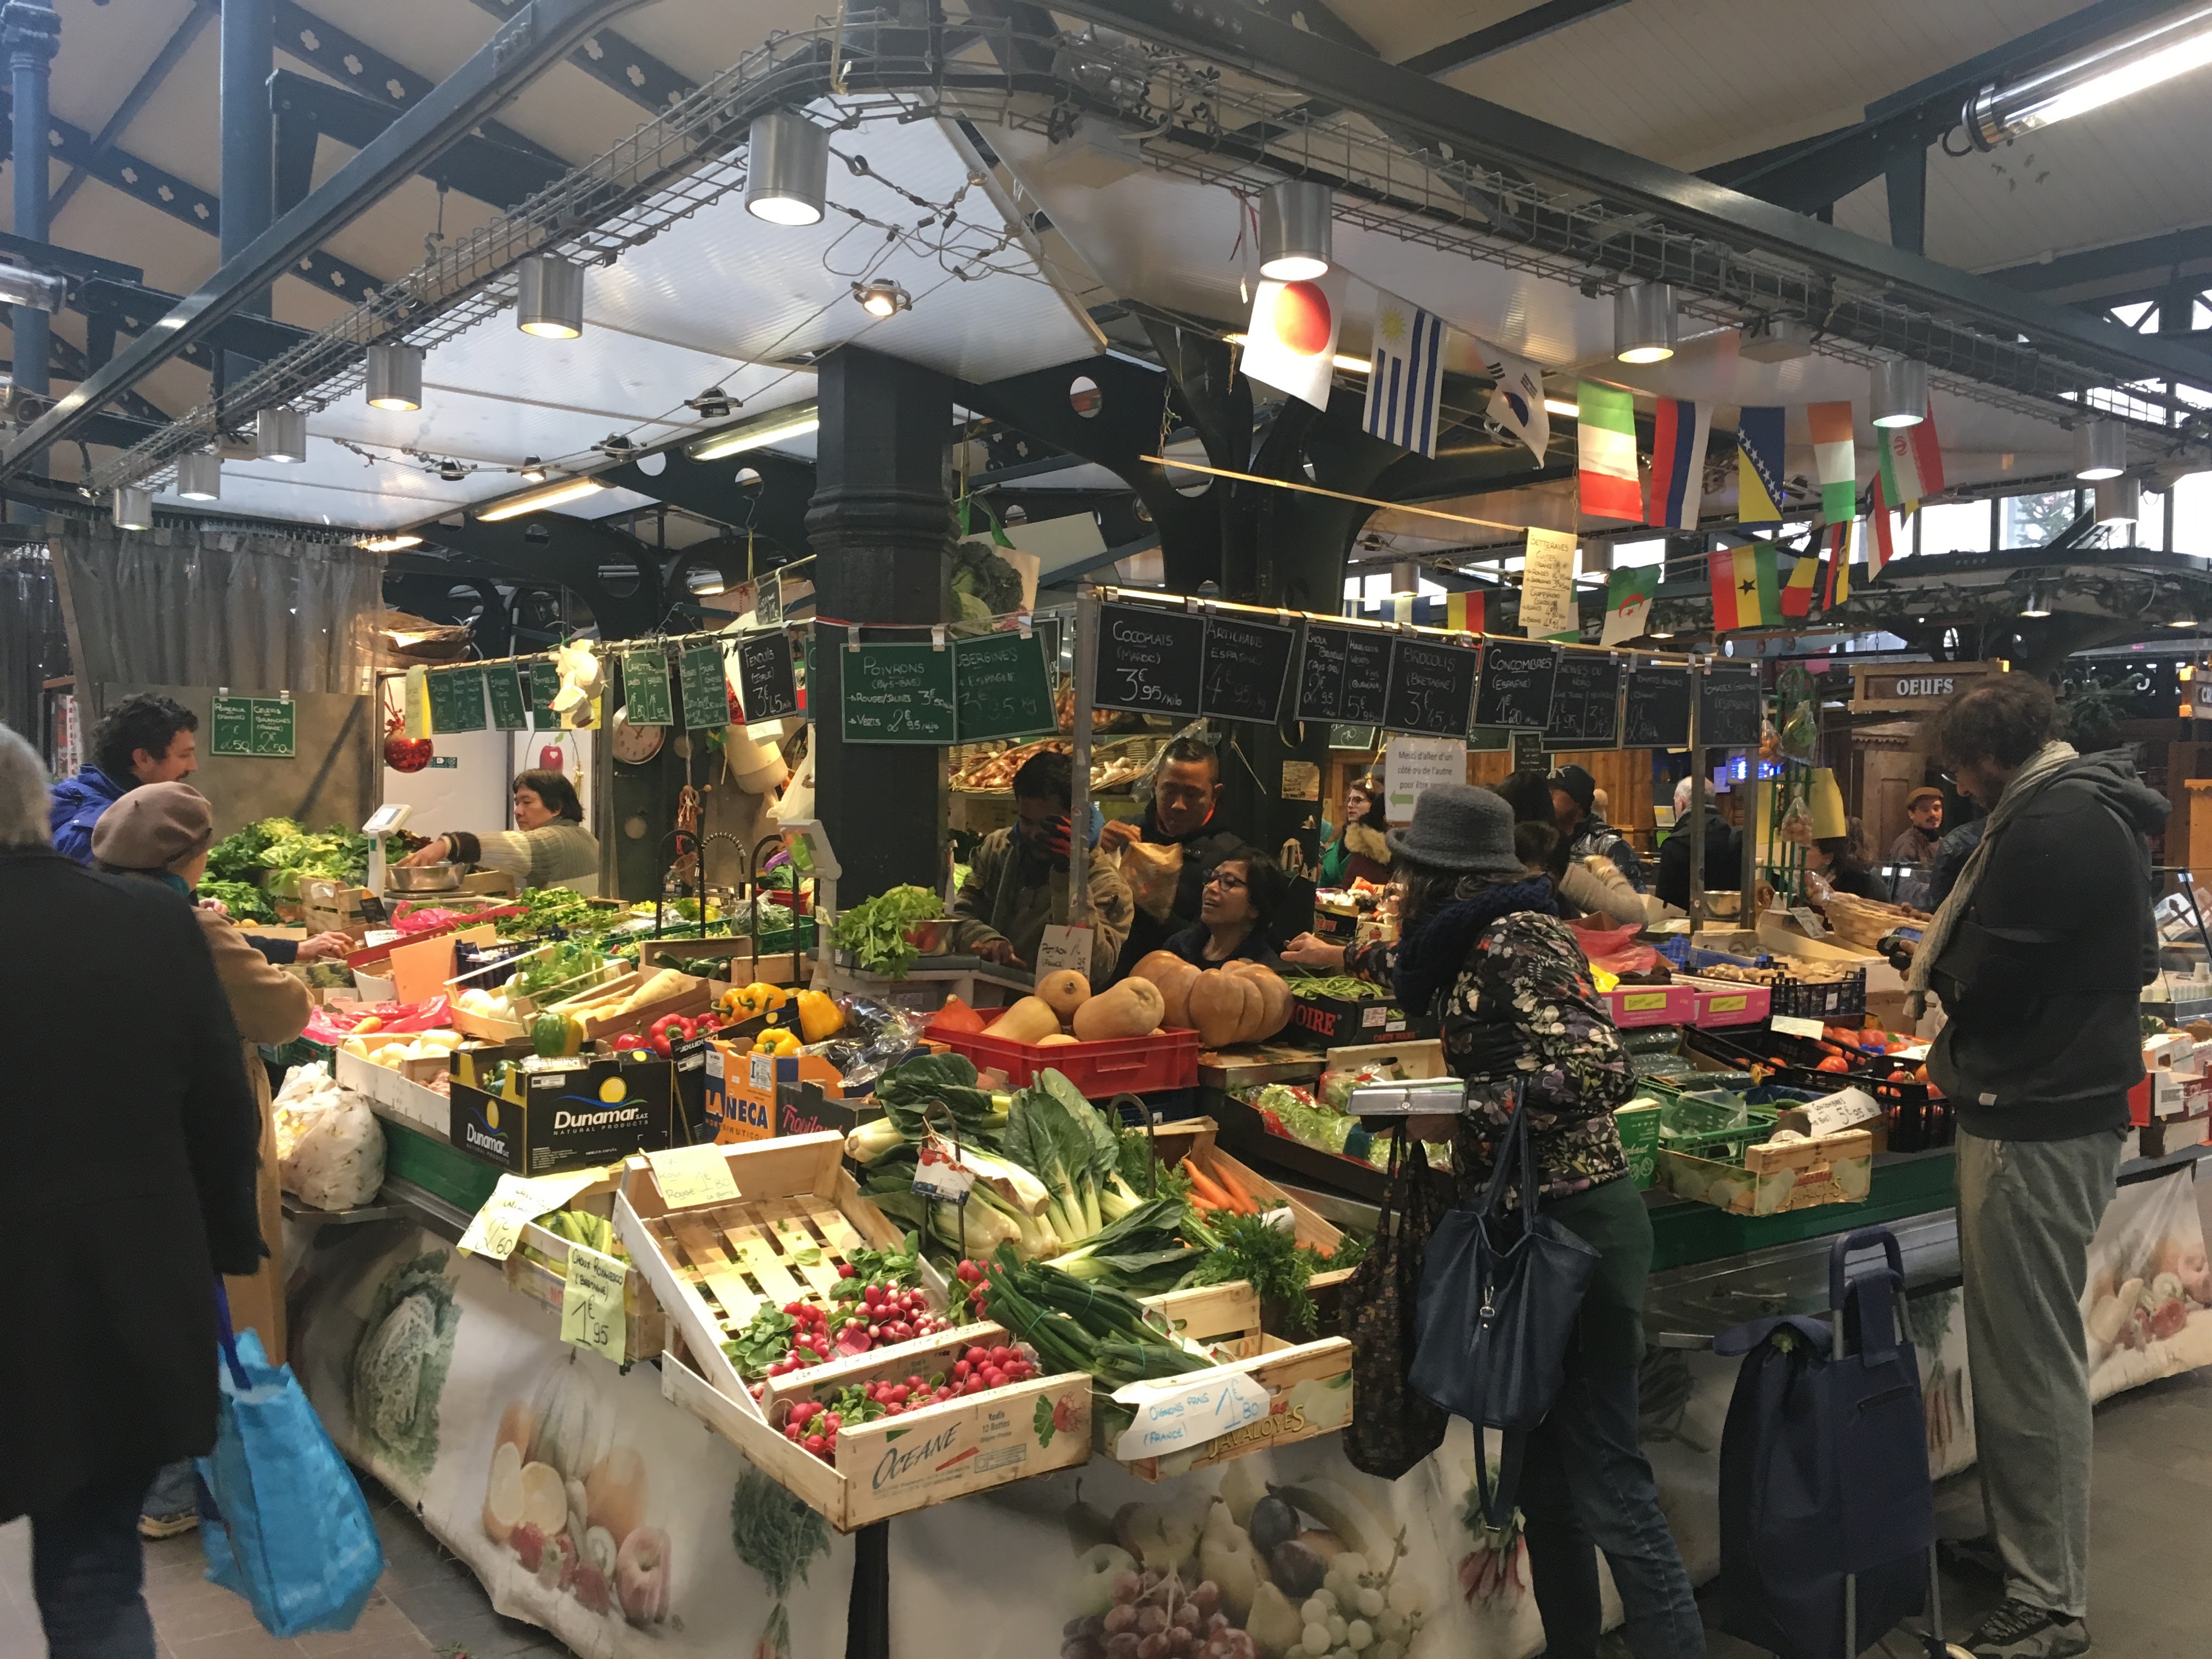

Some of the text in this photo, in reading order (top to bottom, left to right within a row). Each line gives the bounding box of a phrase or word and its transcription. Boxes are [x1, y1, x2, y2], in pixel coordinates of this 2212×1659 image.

[1531, 535, 1569, 552] BETTERAVES
[1113, 620, 1173, 646] COCOPLATS
[863, 657, 924, 676] POIVRONS
[1117, 648, 1161, 664] (MAROC)
[1404, 647, 1455, 672] BROCOLIS
[1489, 648, 1553, 670] CONCOMBRES
[1897, 678, 1953, 696] OEUFS
[1398, 751, 1453, 761] Merci d'aller d'un
[1397, 766, 1411, 774] côté
[1431, 767, 1453, 775] l'autre
[1400, 782, 1414, 791] pour
[1292, 1002, 1336, 1036] OIRE
[553, 1120, 649, 1136] NATURAL PRODUCTS
[554, 1107, 639, 1130] Dunamar
[466, 1122, 505, 1154] Dunamar
[1149, 1392, 1210, 1421] OIGNONS FRAIS
[1143, 1422, 1188, 1447] (FRANCE)
[1209, 1403, 1305, 1459] JAVALOYES
[872, 1421, 962, 1490] OCEANE
